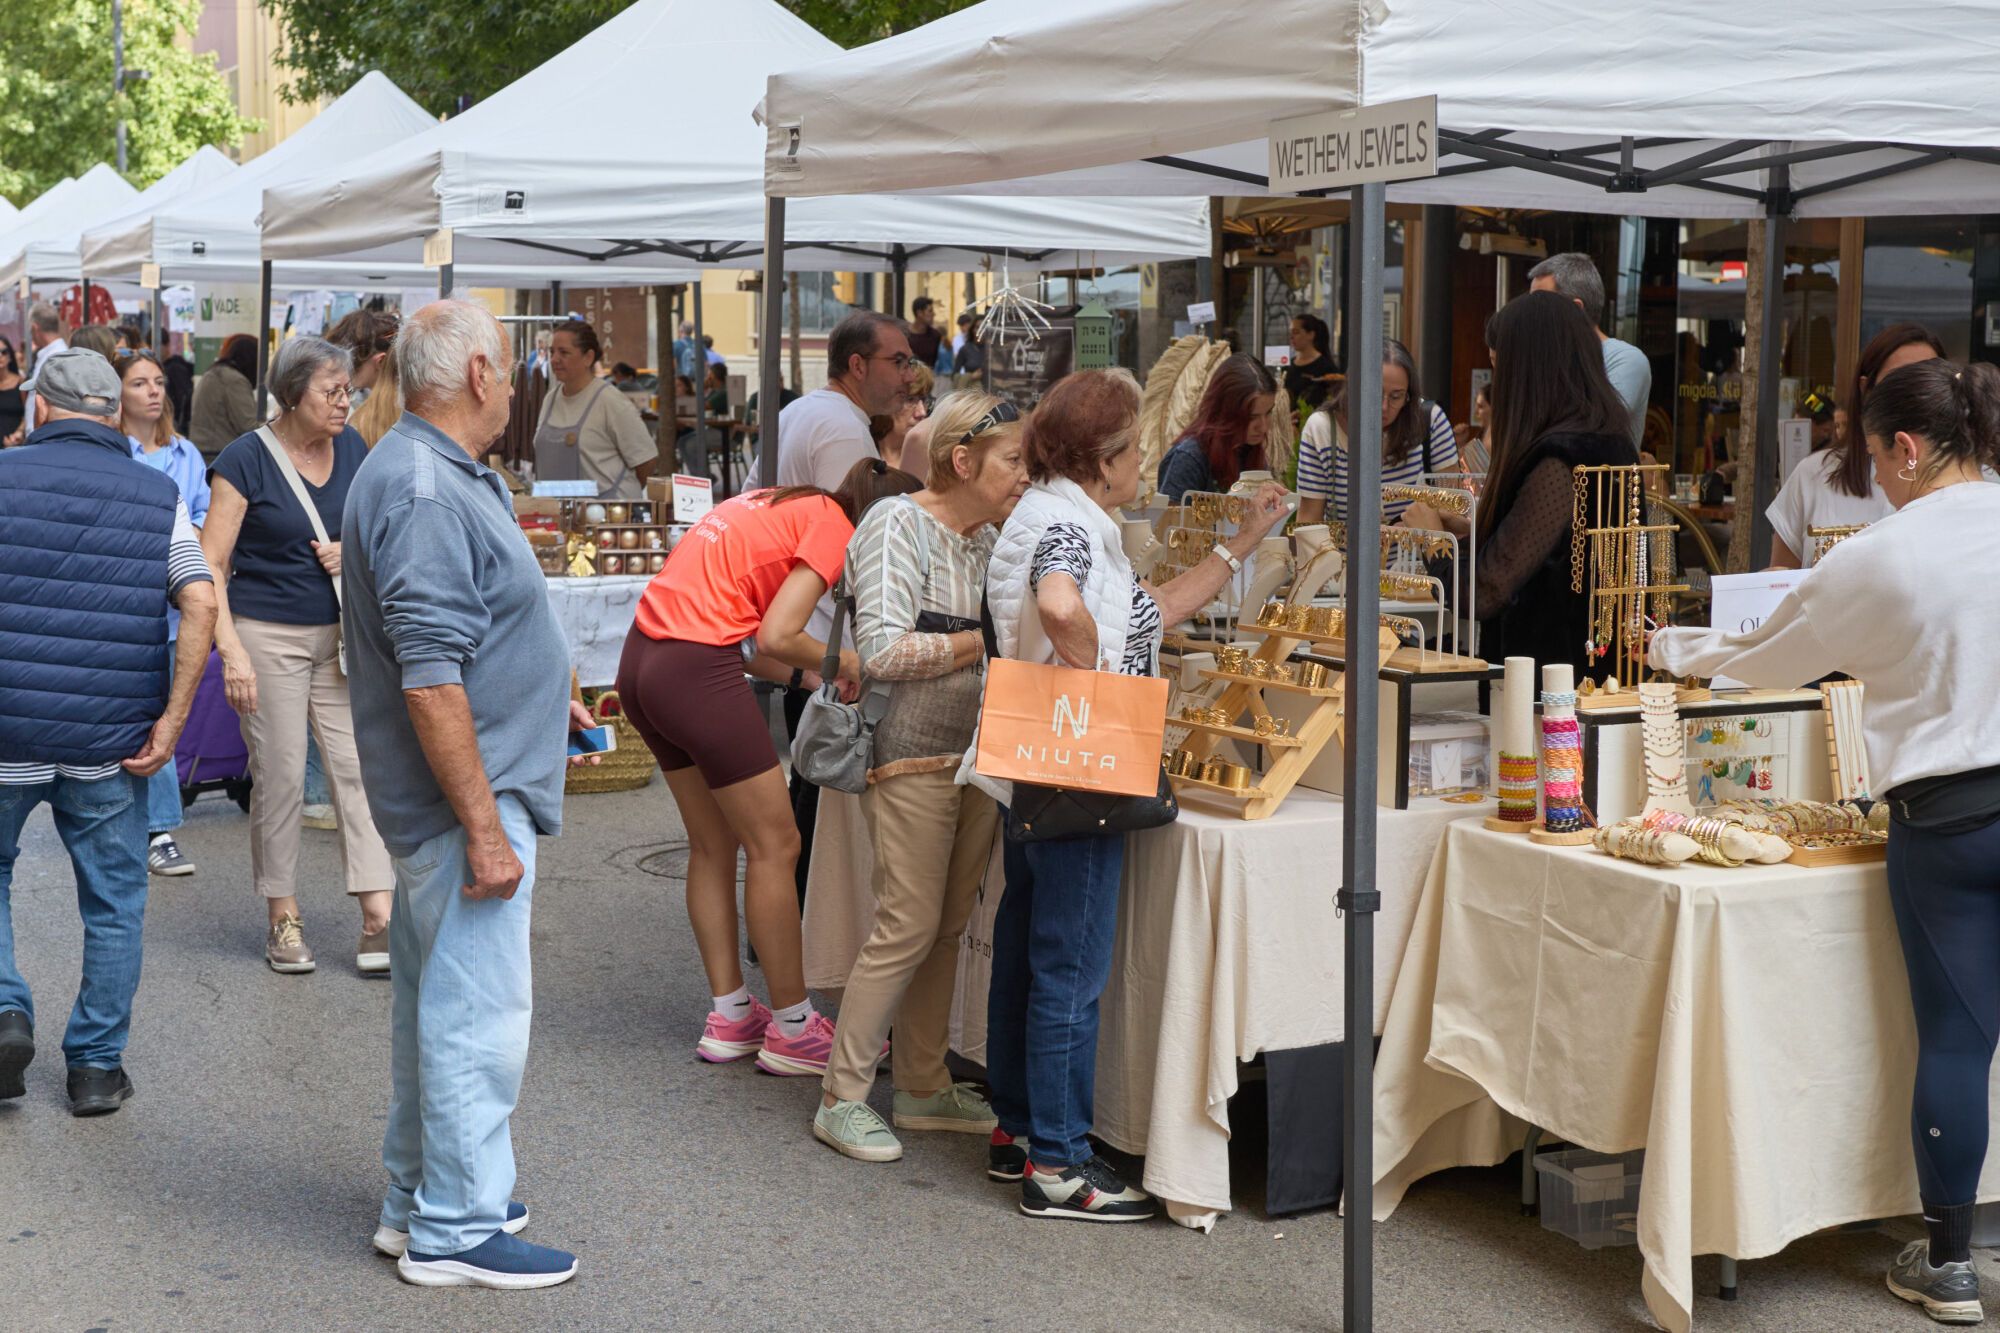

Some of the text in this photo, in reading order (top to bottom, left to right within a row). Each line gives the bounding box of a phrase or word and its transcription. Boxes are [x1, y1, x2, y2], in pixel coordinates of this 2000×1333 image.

[1276, 120, 1428, 179] WETHEM JEWELS
[1016, 743, 1117, 771] NIUTA
